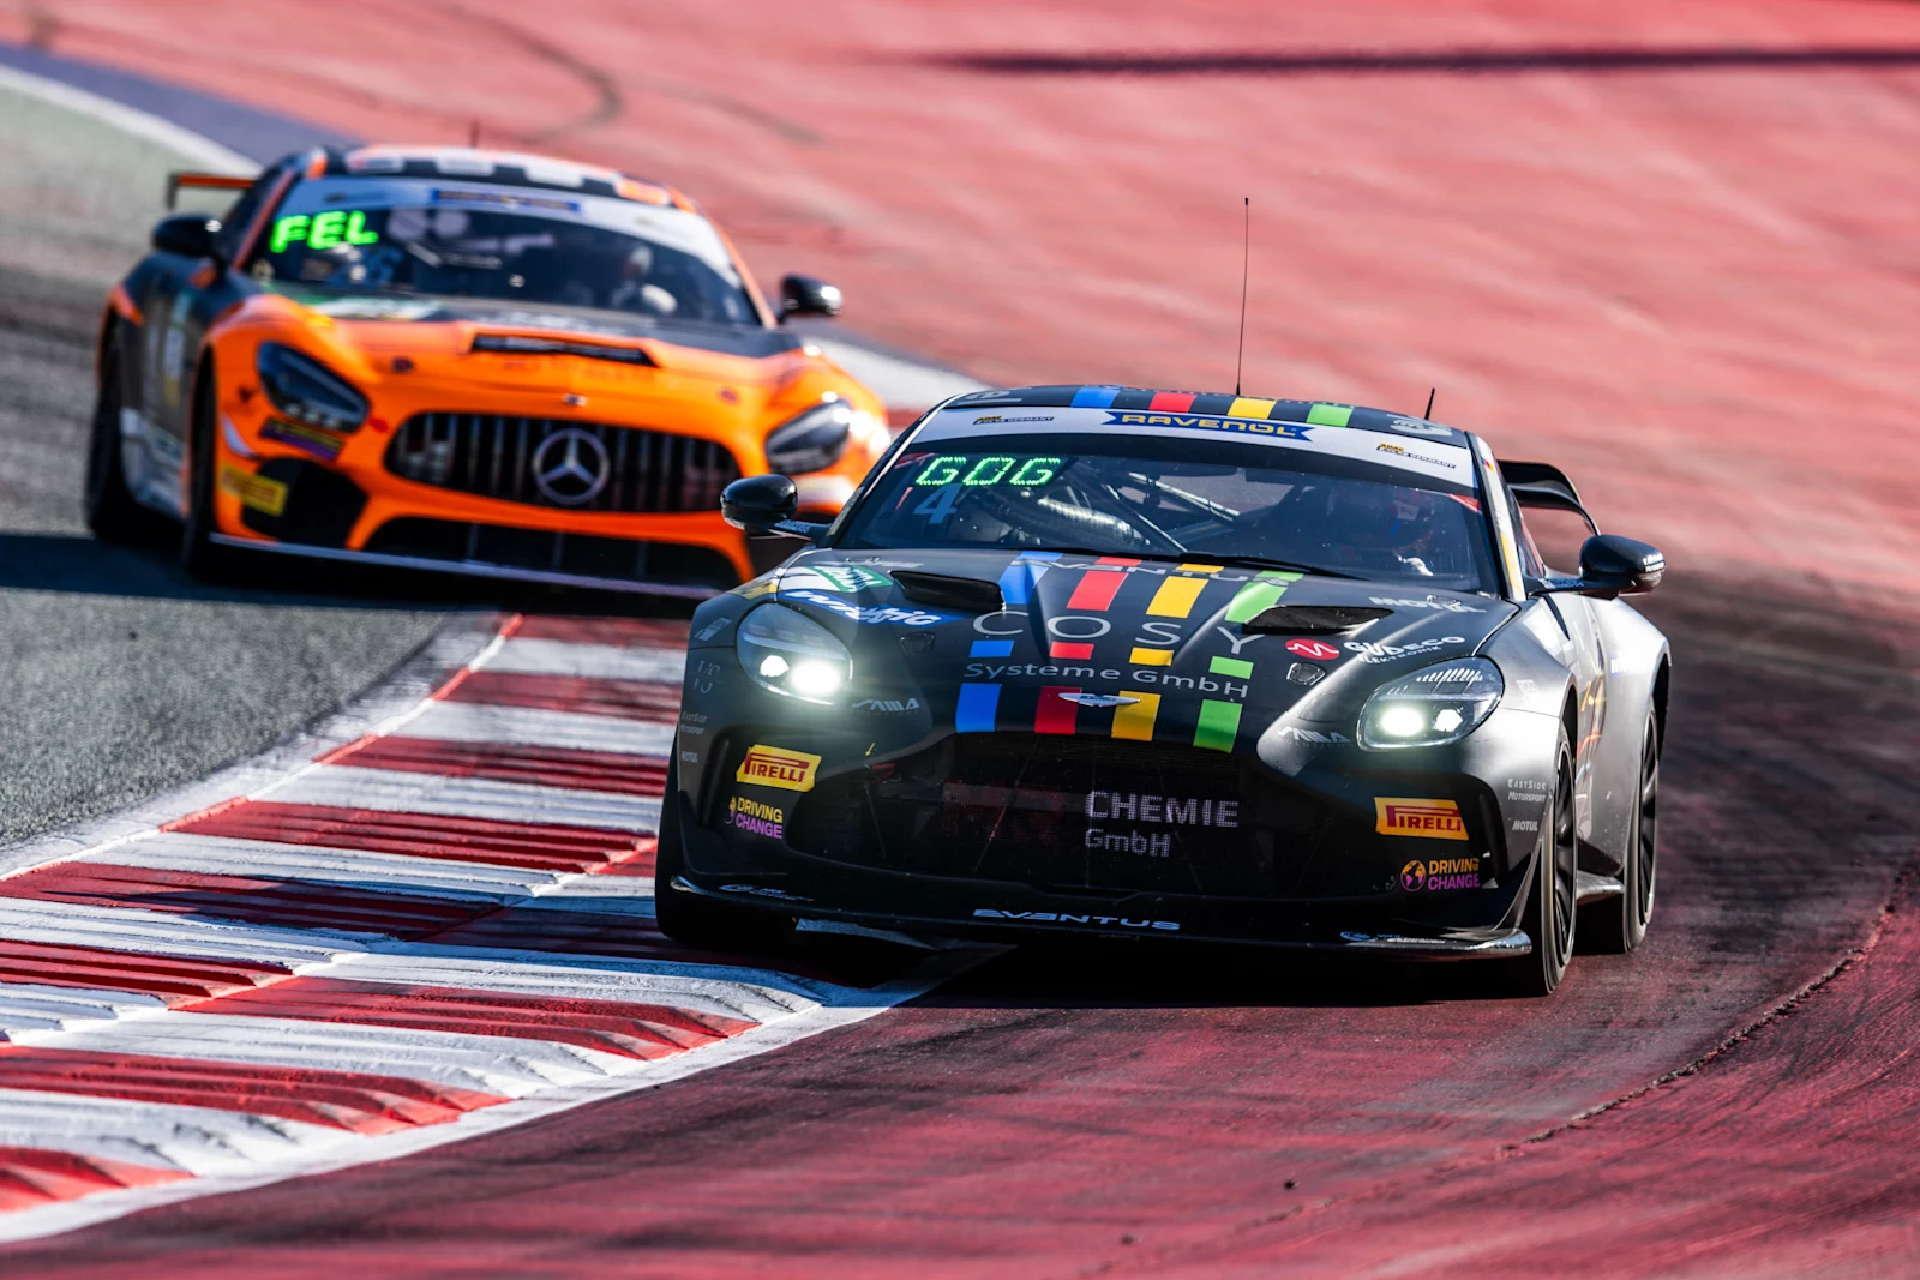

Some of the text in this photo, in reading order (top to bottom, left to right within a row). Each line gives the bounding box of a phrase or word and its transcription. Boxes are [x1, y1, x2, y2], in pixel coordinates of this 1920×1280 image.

[271, 210, 378, 253] FEL
[916, 456, 1061, 486] GOG
[972, 611, 1264, 654] COSY
[964, 663, 1249, 698] Systeme GmbH
[744, 751, 810, 783] PIRELLI
[737, 797, 783, 822] DRIVING
[1085, 790, 1239, 828] CHEMIE
[1385, 804, 1462, 832] PIRELLI
[735, 814, 783, 839] CHANGE
[1085, 829, 1171, 857] GmbH
[1428, 857, 1480, 874] DRIVING
[1427, 874, 1481, 891] CHANGE
